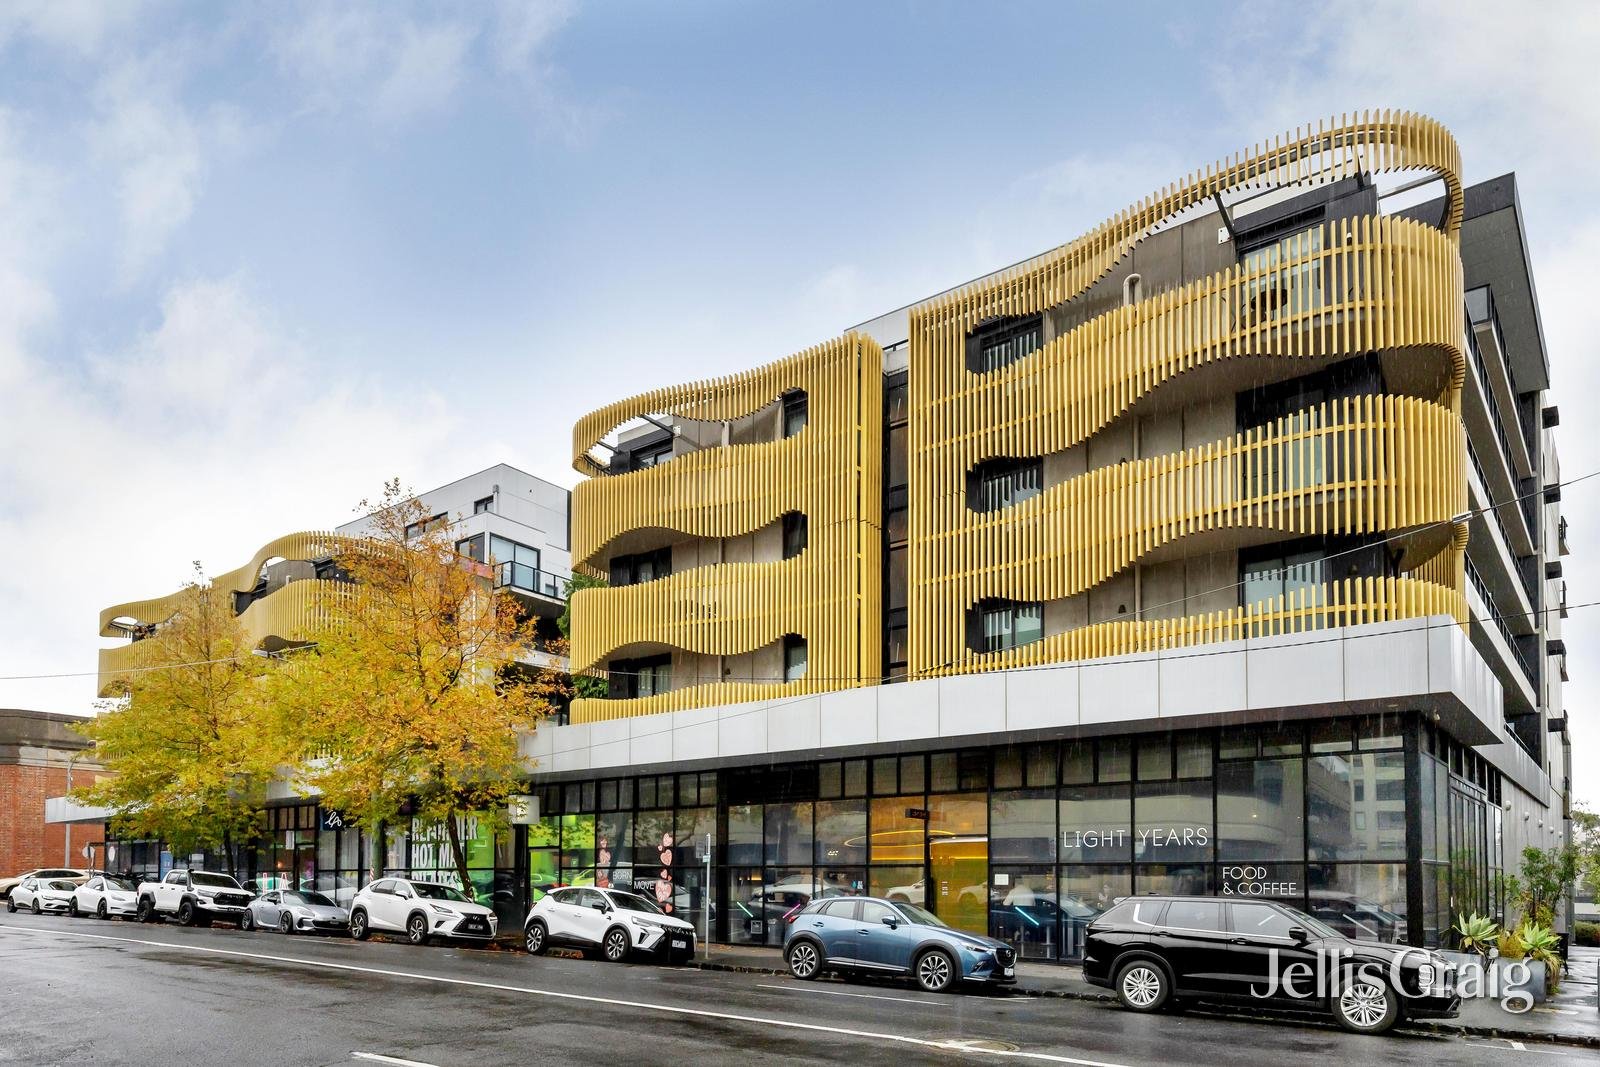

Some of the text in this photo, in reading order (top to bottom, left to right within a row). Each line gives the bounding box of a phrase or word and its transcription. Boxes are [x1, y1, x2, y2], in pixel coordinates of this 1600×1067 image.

[1063, 827, 1208, 848] LIGHT YEARS
[612, 871, 633, 880] BORN
[1222, 866, 1267, 880] FOOD
[633, 881, 655, 890] MOVE
[1223, 882, 1297, 895] & COFFEE
